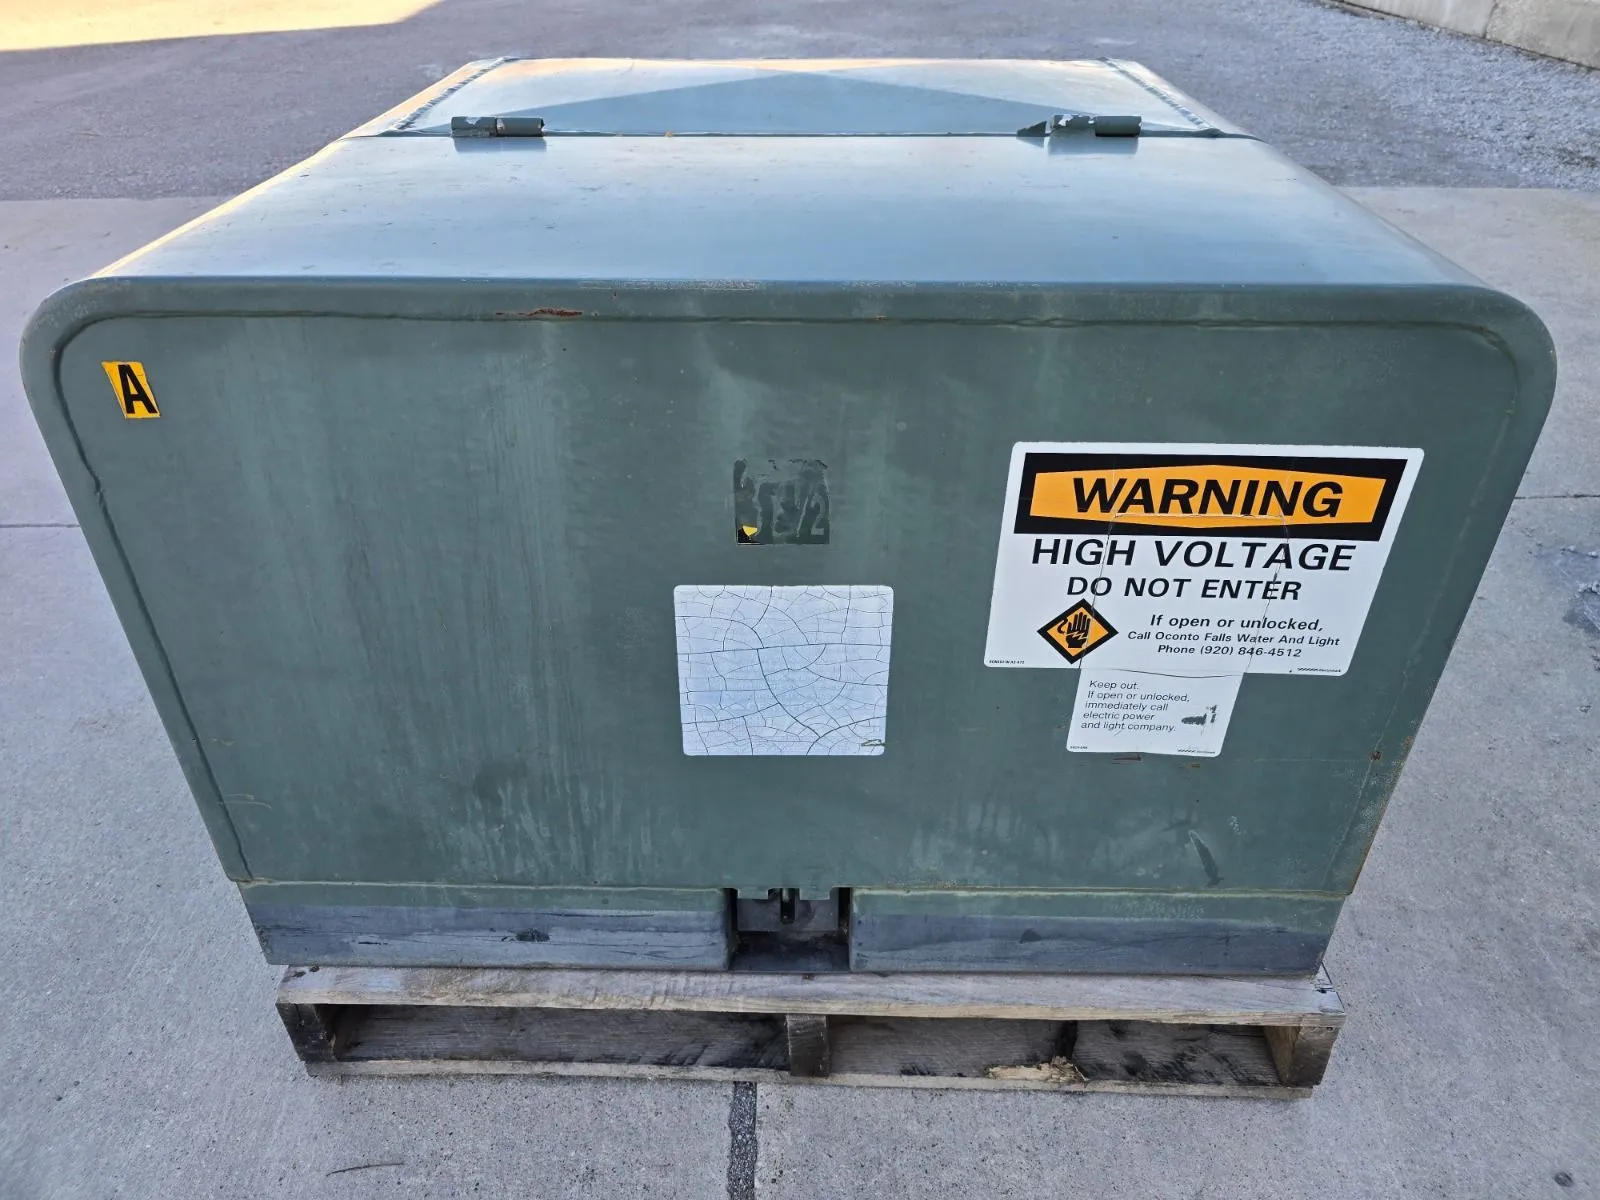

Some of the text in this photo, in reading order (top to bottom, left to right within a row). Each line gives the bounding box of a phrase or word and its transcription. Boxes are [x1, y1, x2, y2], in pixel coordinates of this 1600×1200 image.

[118, 364, 158, 414] A
[1072, 477, 1343, 518] WARNING
[1031, 538, 1356, 571] HIGH VOLTAGE
[1066, 576, 1302, 601] DO NOT ENTER
[1150, 614, 1324, 632] If open or unlocked,
[1127, 631, 1340, 647] Call Oconto Falls Water And Light
[1157, 644, 1302, 657] Phone (920) 846-4512
[1089, 680, 1140, 690] Keep out.
[1087, 690, 1096, 699] If
[1097, 692, 1123, 701] open
[1140, 692, 1190, 703] unlocked,
[1085, 701, 1169, 712] immediately call
[1083, 711, 1155, 721] electric power
[1080, 721, 1176, 732] and light company.
